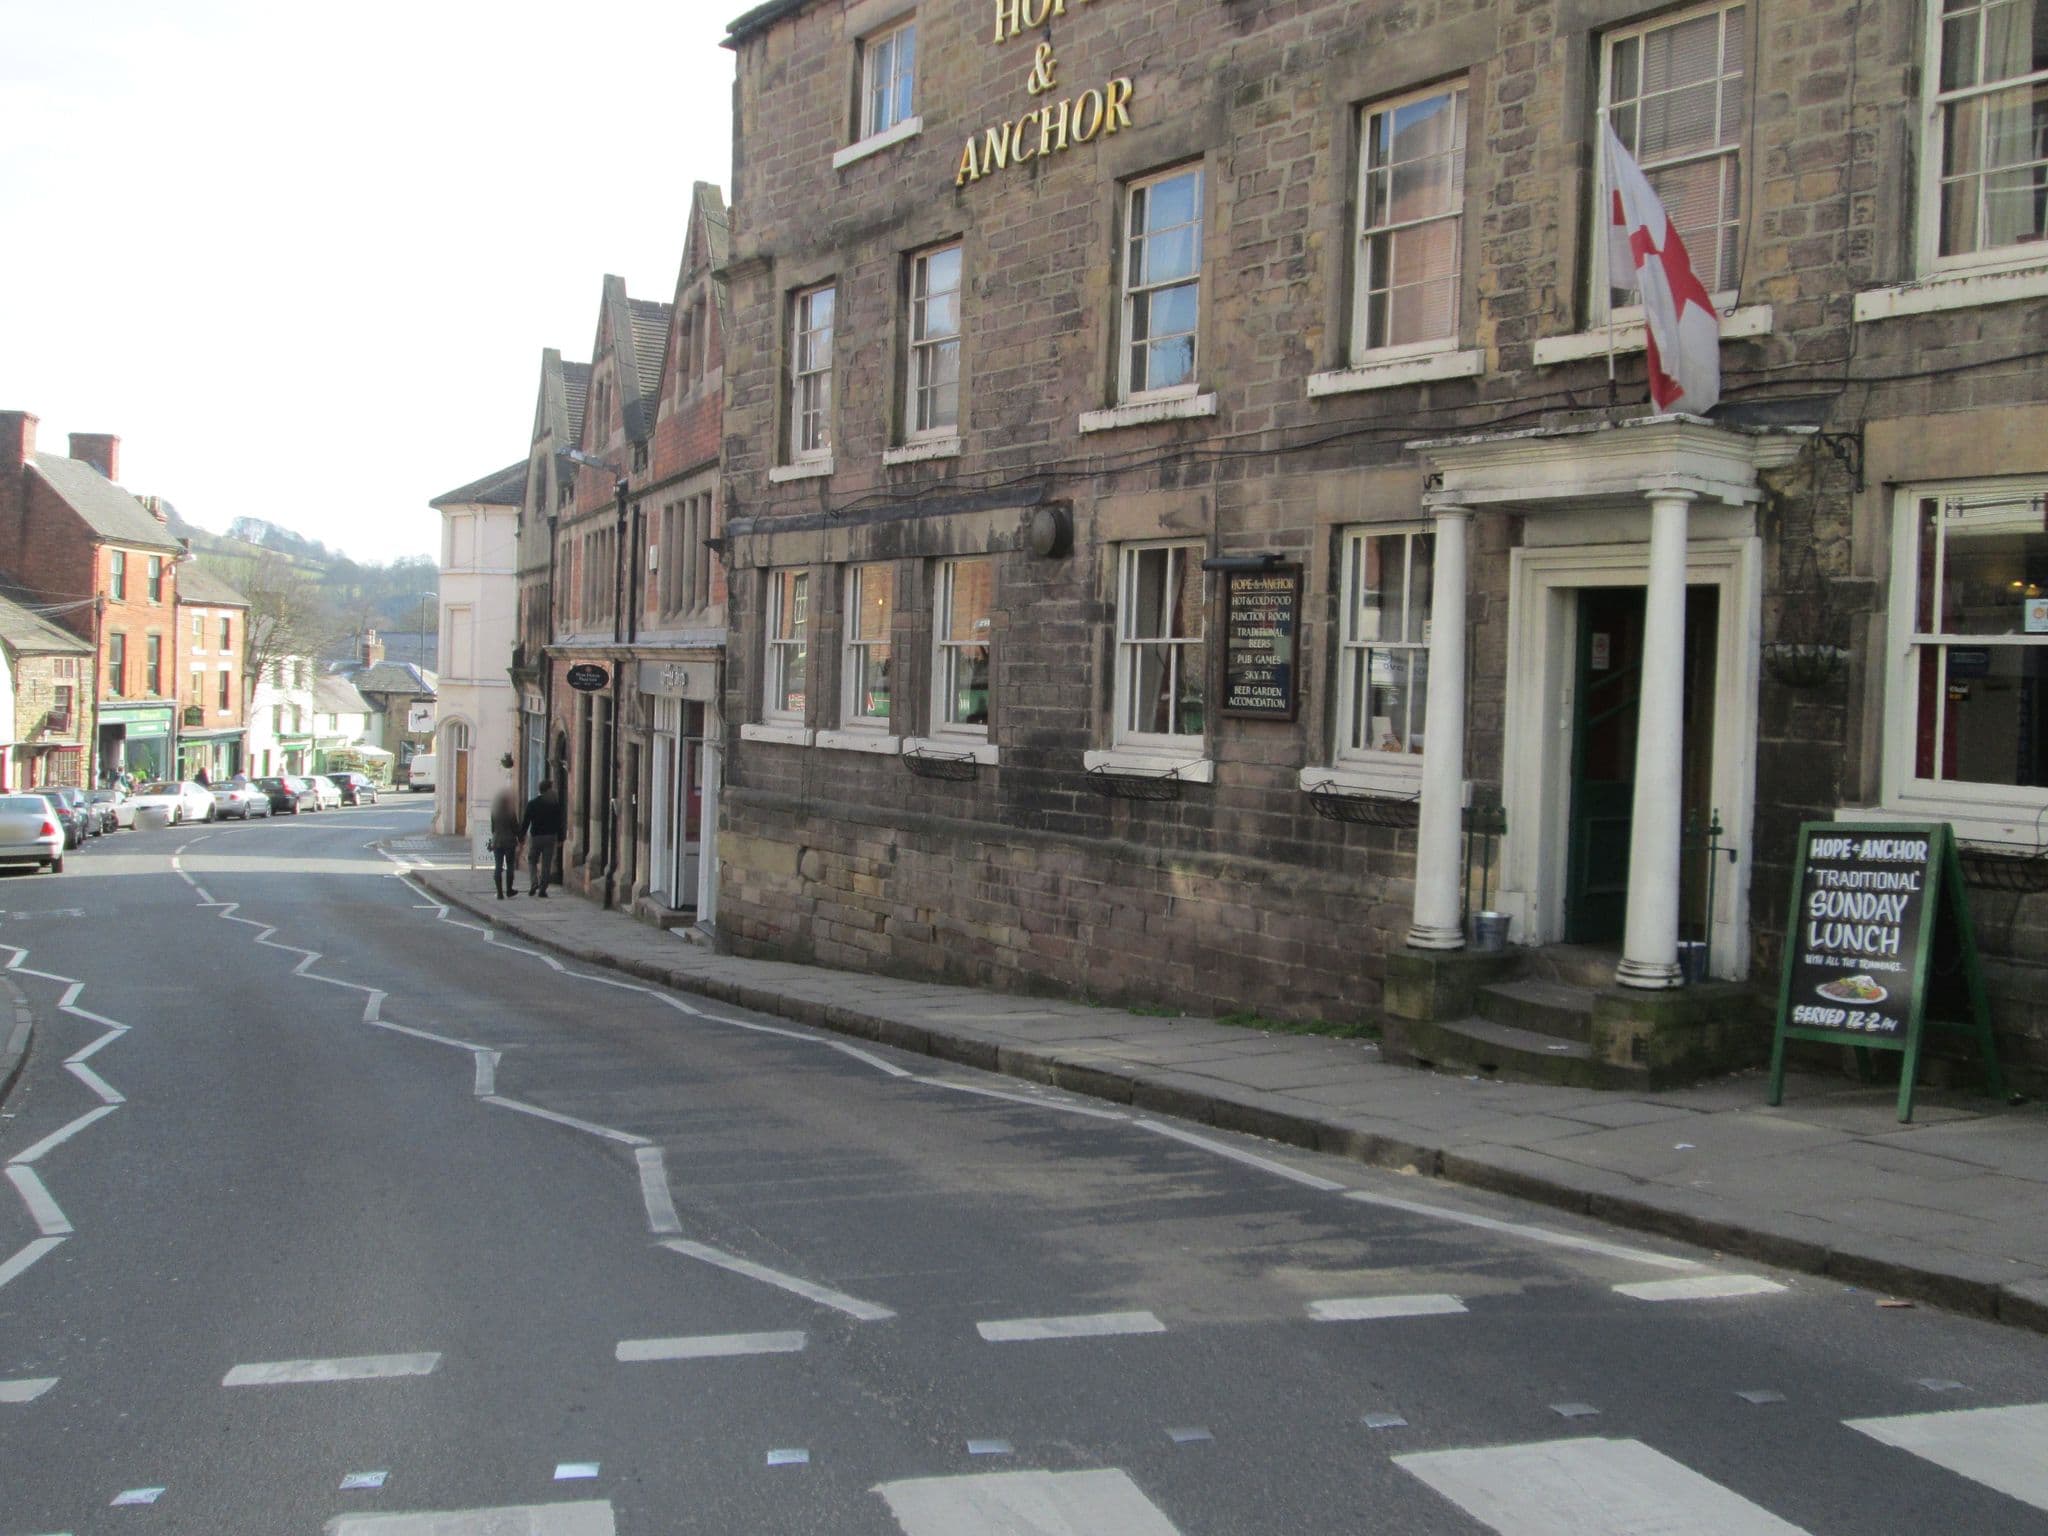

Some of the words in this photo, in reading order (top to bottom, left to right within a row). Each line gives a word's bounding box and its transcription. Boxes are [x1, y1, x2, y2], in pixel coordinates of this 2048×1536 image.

[1027, 42, 1056, 95] &
[955, 77, 1133, 186] ANCHOR
[1270, 596, 1291, 606] FOOD
[1231, 612, 1265, 621] FUNCTION
[1268, 612, 1290, 621] ROOM
[1237, 628, 1284, 637] TRADITIONAL
[1248, 639, 1271, 648] BEERS
[1237, 654, 1252, 664] PUB
[1255, 655, 1281, 664] GAMES
[1245, 671, 1260, 680] SKY
[1261, 671, 1272, 680] TV
[1234, 685, 1251, 695] BEER
[1252, 687, 1282, 696] GARDEN
[1810, 838, 1852, 860] HOPE
[1860, 839, 1928, 863] ANCHOR
[1809, 890, 1909, 922] SUNDAY
[1809, 921, 1900, 954] LUNCH
[1793, 1005, 1846, 1027] SERVED
